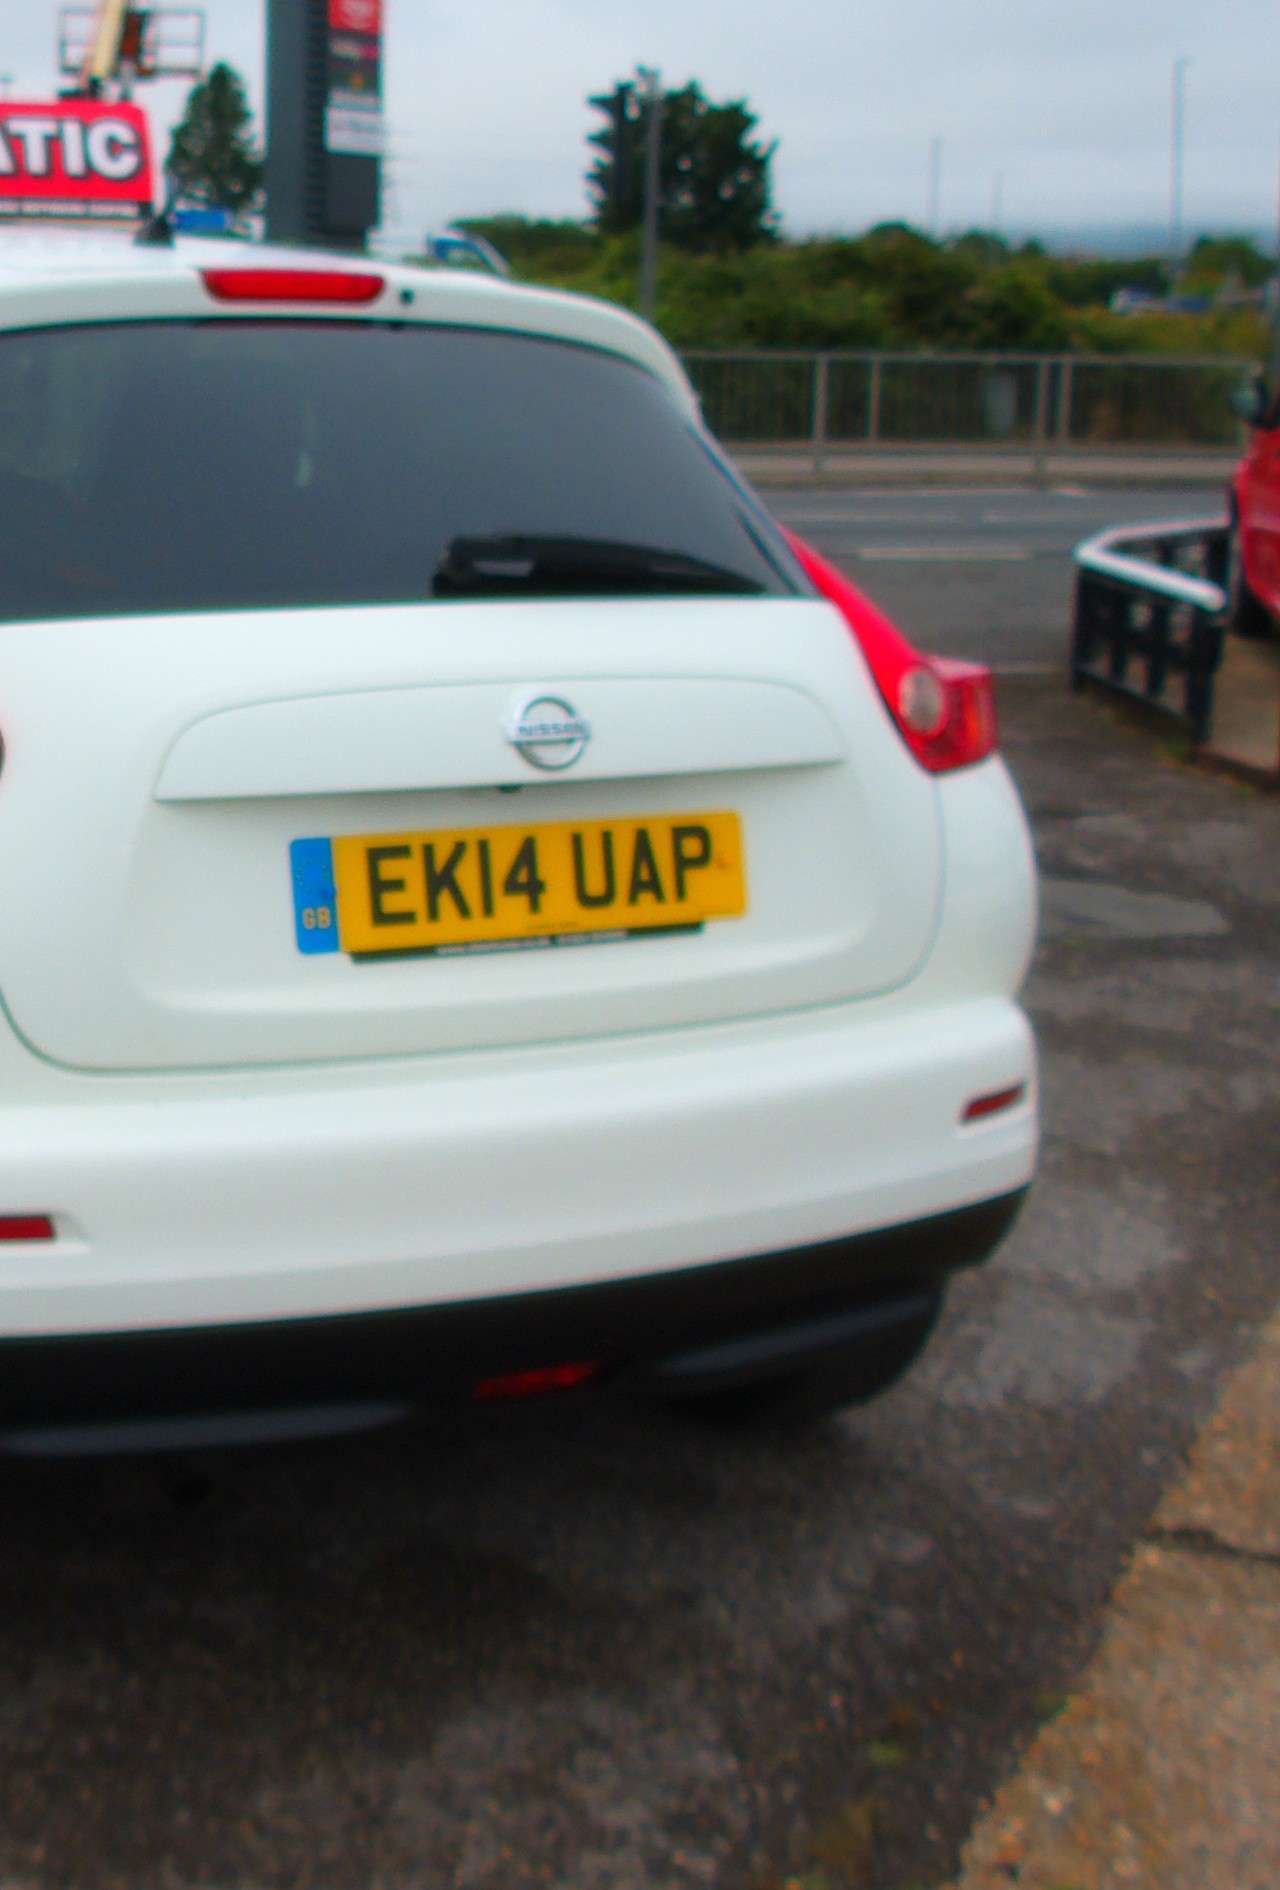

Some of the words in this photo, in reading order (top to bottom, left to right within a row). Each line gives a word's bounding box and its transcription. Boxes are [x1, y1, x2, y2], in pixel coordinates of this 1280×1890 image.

[518, 722, 587, 737] NISSAN
[365, 836, 547, 928] EK14
[572, 825, 712, 908] UAP
[302, 907, 331, 929] GB
